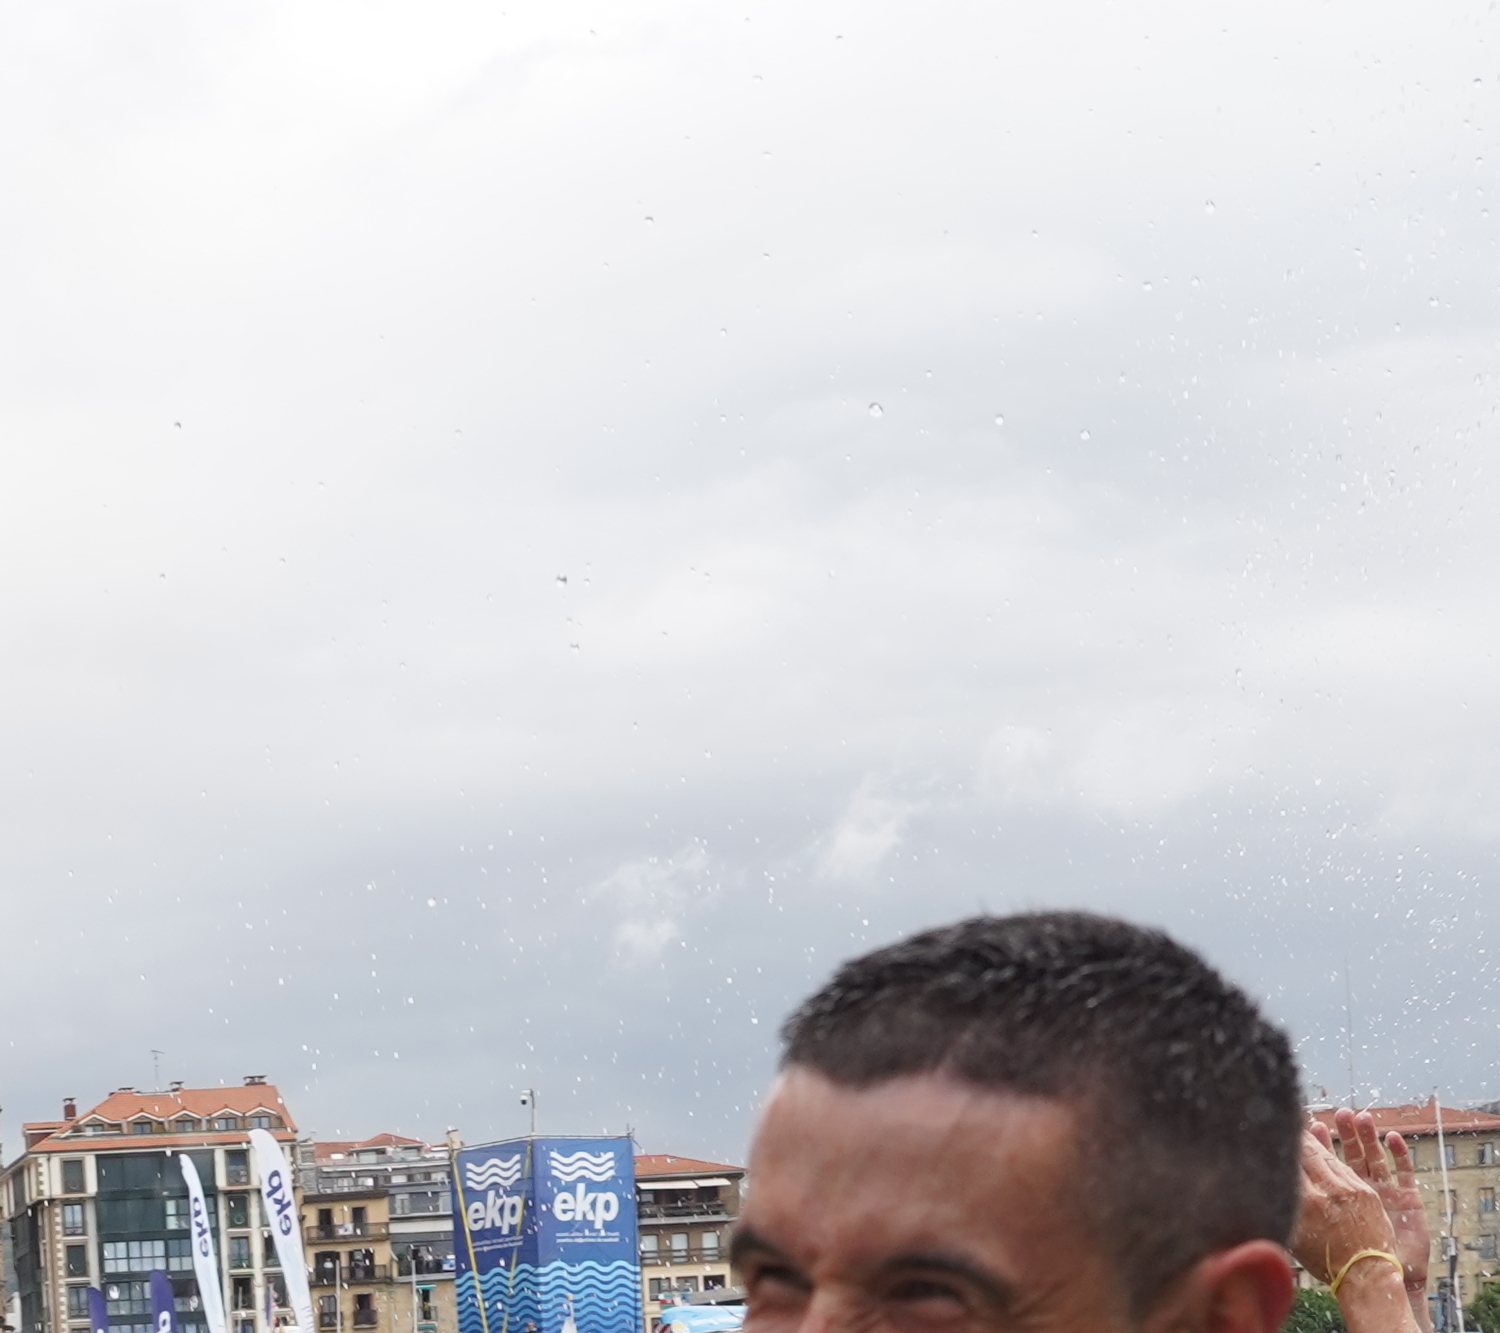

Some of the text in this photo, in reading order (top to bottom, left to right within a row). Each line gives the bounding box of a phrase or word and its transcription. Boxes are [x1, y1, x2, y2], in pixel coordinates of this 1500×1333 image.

[266, 1170, 293, 1237] ekp
[466, 1190, 525, 1235] ekp
[552, 1183, 620, 1230] ekp
